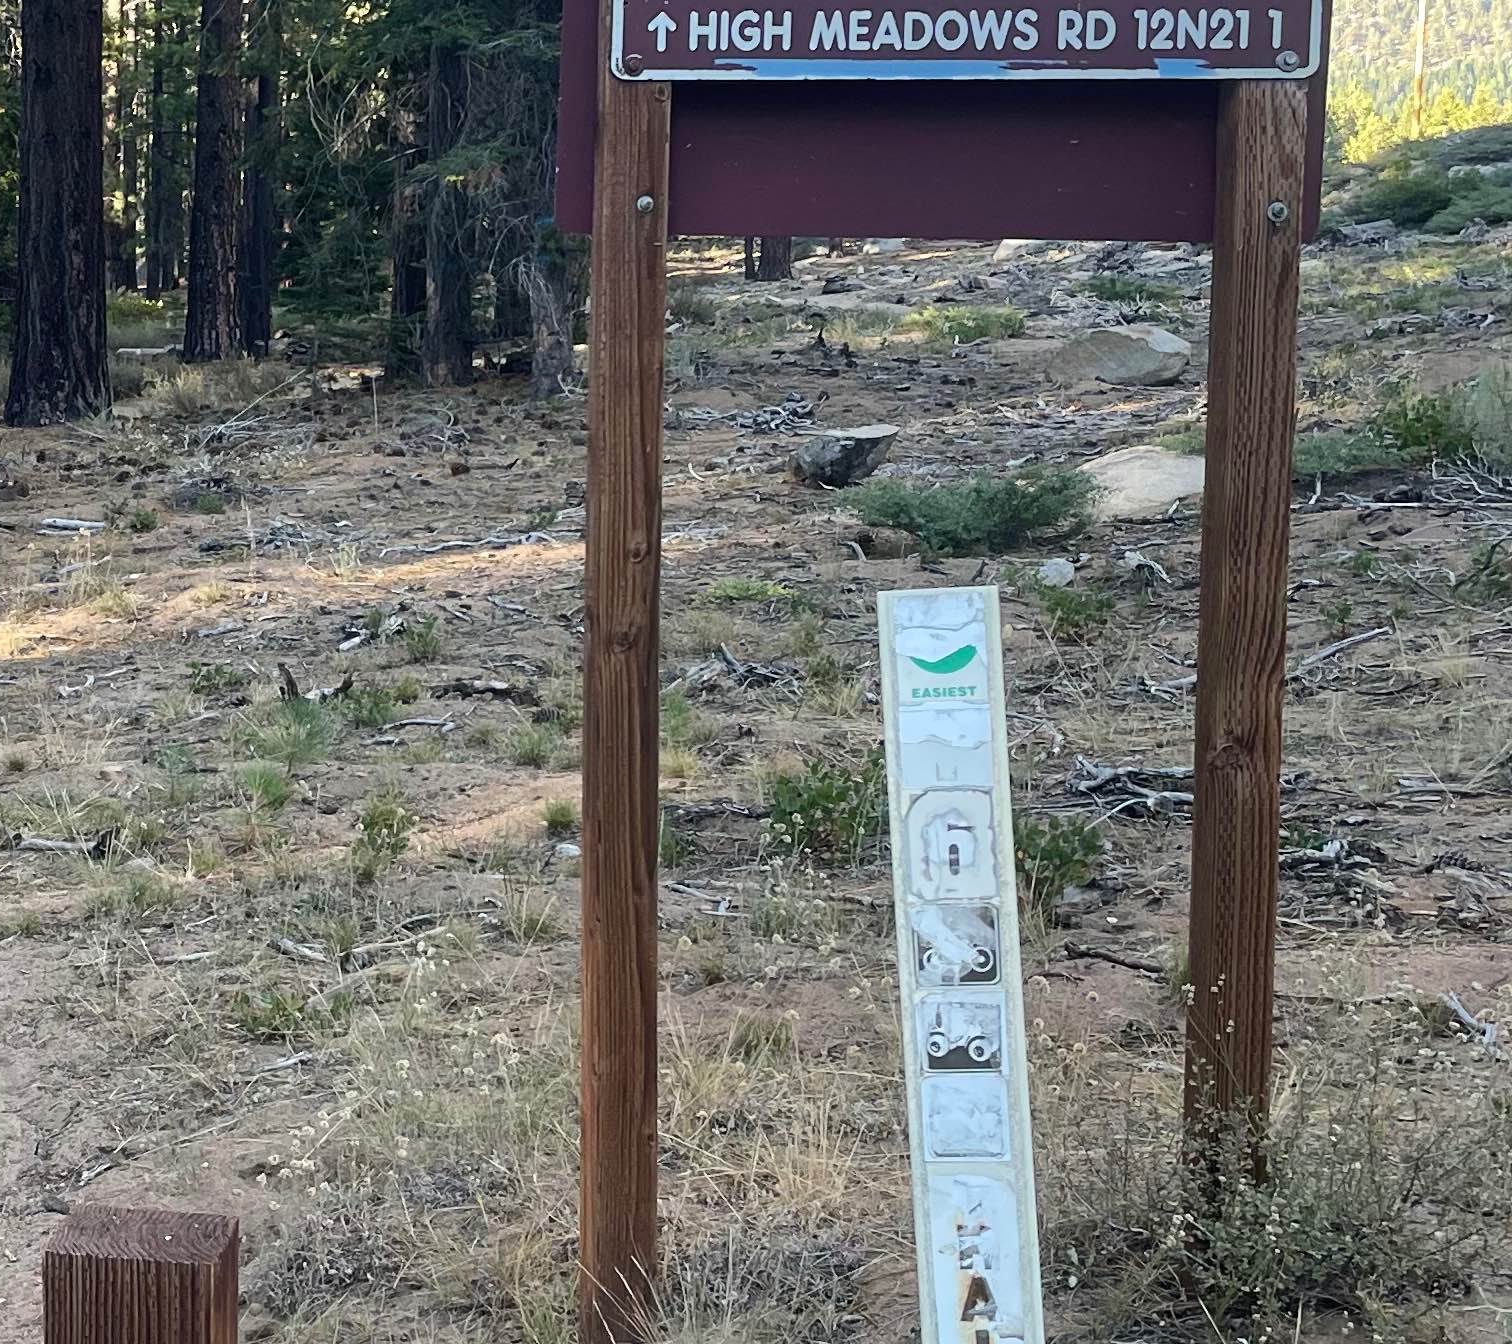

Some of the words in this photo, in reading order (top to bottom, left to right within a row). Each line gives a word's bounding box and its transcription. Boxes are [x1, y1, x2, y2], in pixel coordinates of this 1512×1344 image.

[688, 9, 792, 51] HIGH
[809, 9, 1038, 51] MEADOWS
[1057, 9, 1116, 50] RD
[1133, 8, 1250, 49] 12N21
[911, 686, 977, 699] EASIEST
